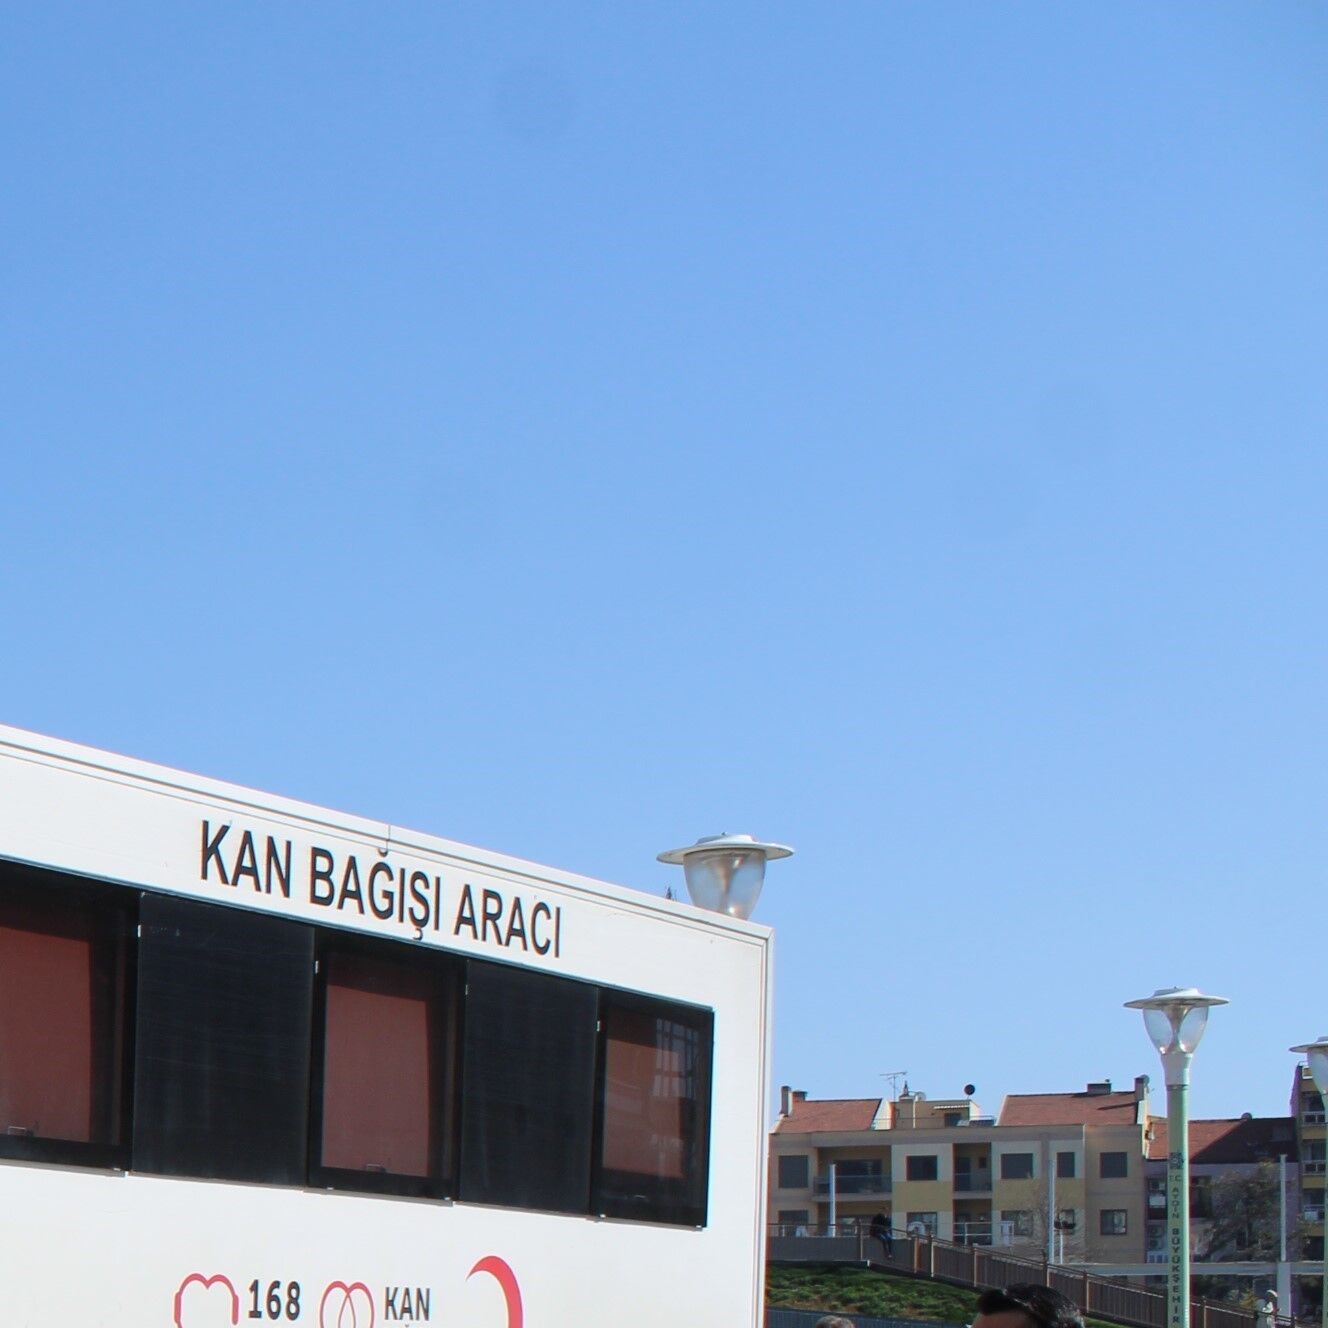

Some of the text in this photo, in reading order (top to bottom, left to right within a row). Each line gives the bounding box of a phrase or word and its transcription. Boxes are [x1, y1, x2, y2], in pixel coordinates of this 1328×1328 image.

[200, 820, 561, 958] KAN BAĞIŞI ARACI
[247, 1279, 302, 1321] 168
[384, 1286, 431, 1321] KAN
